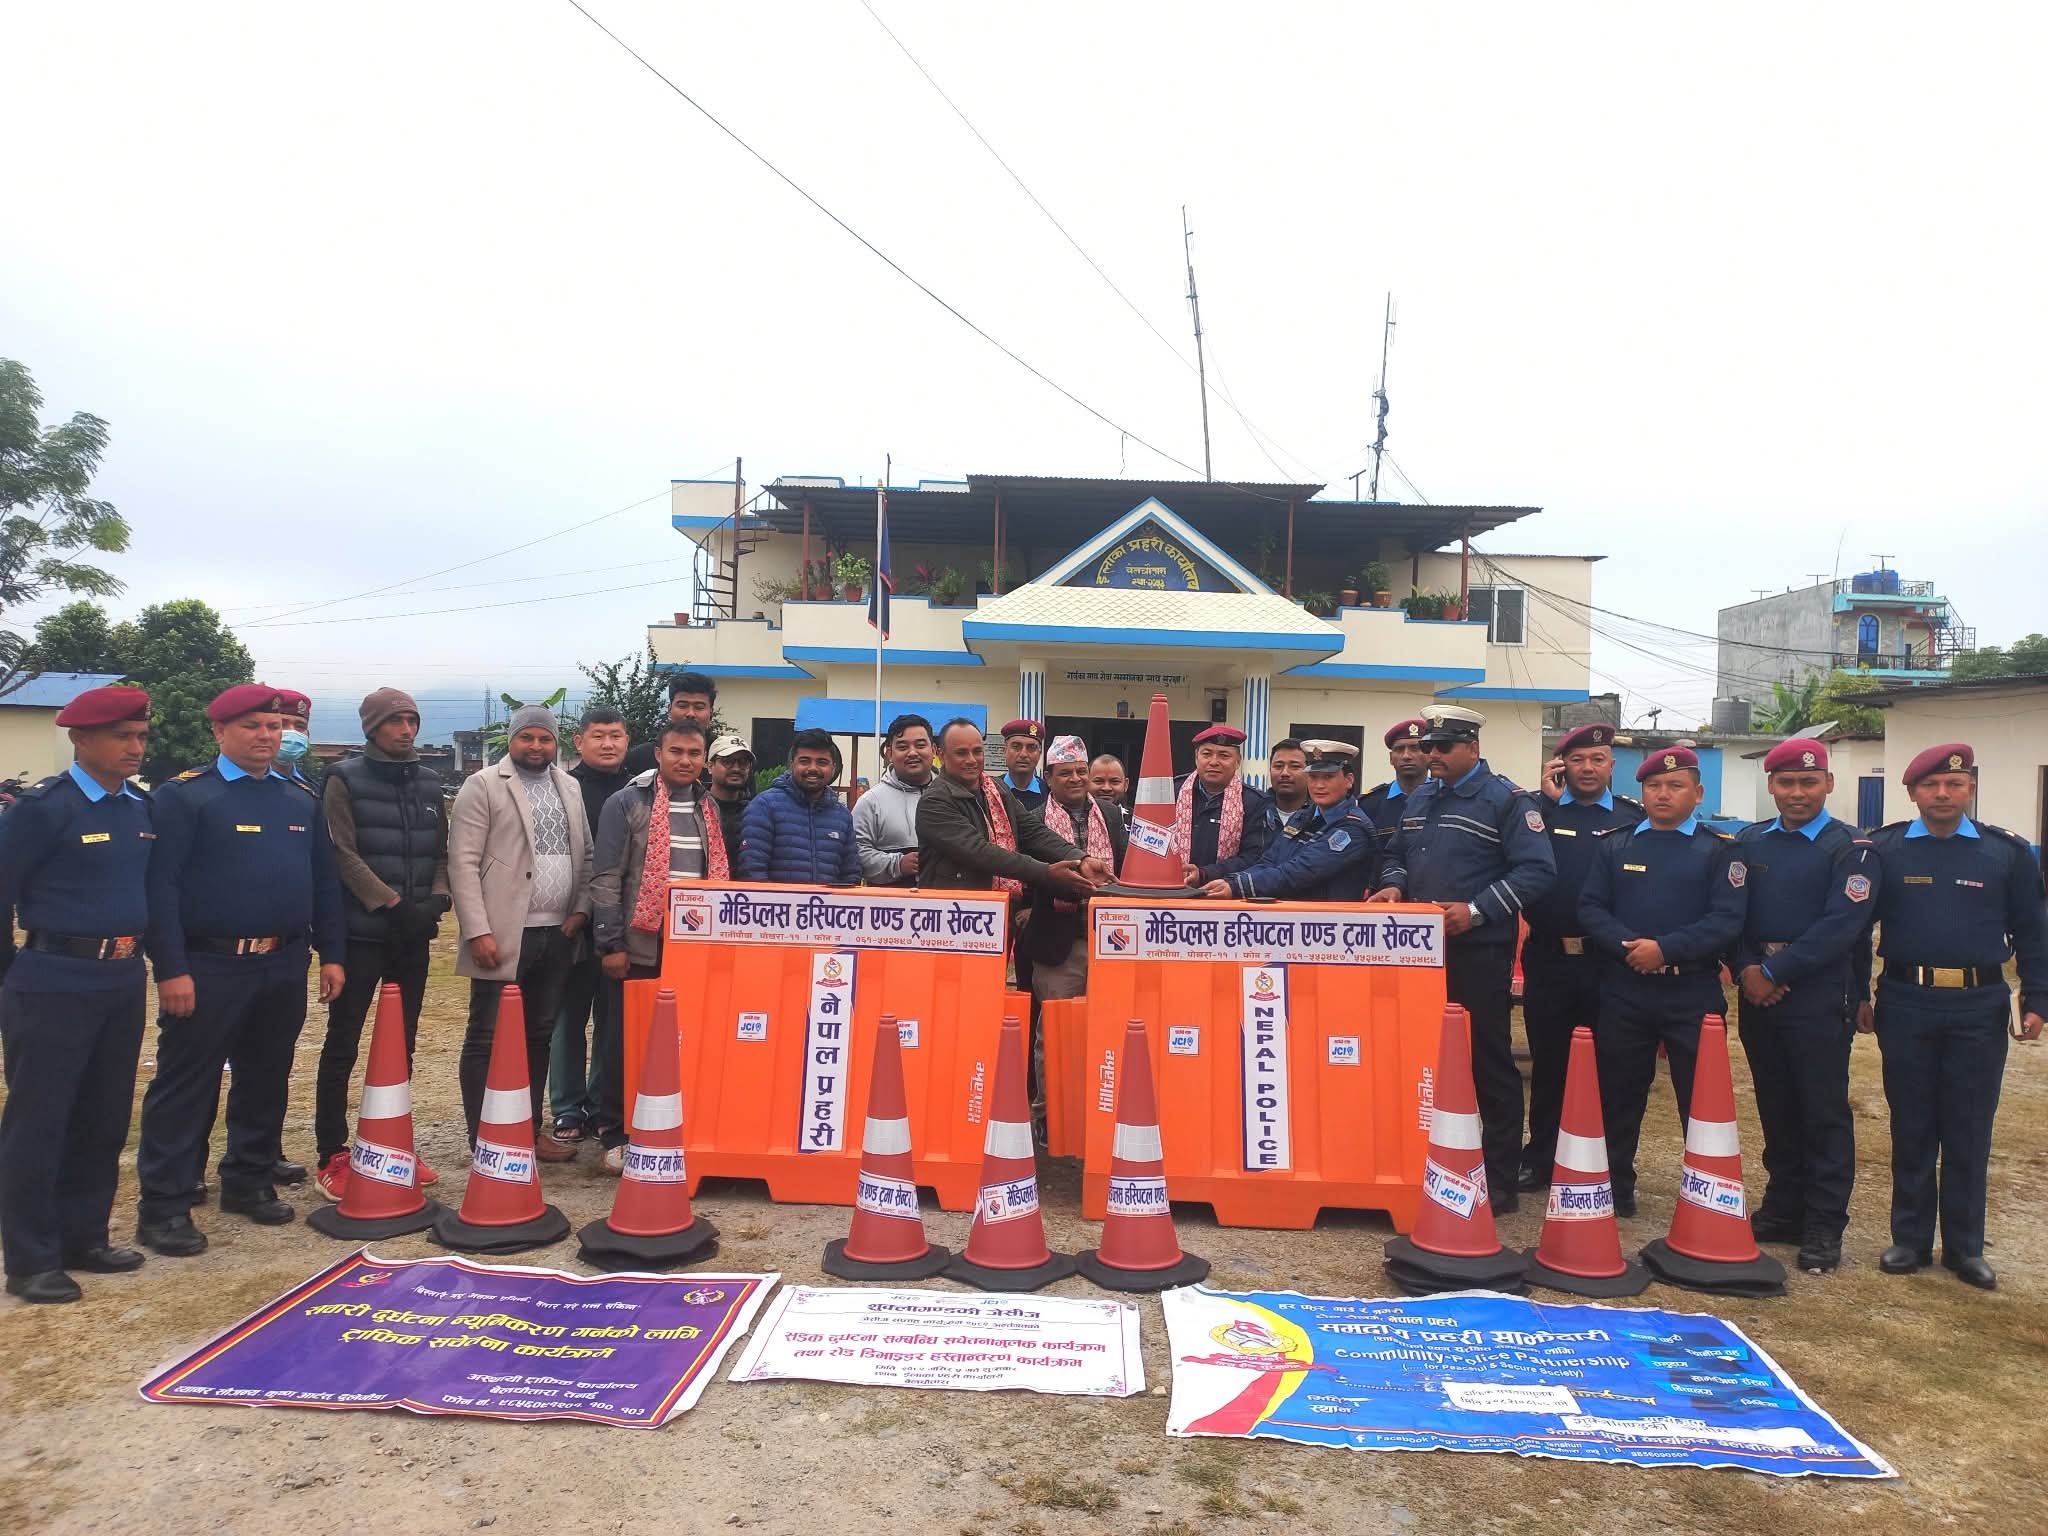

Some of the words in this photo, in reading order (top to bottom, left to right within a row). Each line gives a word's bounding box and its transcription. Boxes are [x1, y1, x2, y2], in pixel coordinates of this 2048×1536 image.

[1127, 536, 1165, 554] प्रहरी
[1165, 544, 1200, 590] कार्यालय
[1144, 836, 1158, 845] JCI
[719, 893, 791, 928] मेडिप्लस
[796, 896, 865, 931] हस्पिटल
[870, 906, 905, 932] एण्ड
[947, 902, 996, 937] सेन्टर
[1145, 911, 1219, 947] मेडिप्लस
[1223, 912, 1295, 948] हस्पिटल
[1300, 922, 1337, 947] एण्ड
[1382, 915, 1434, 950] सेन्टर
[741, 1022, 755, 1032] JCI
[1171, 1037, 1187, 1046] JCI
[1255, 1007, 1276, 1072] NEPAL
[1332, 1046, 1347, 1056] JCI
[1098, 1049, 1115, 1113] Hilltake
[1417, 1066, 1433, 1131] Hilltake
[1256, 1083, 1278, 1165] POLICE
[363, 1145, 384, 1169] सेन्टर
[480, 1144, 500, 1168] सेन्टर
[642, 1154, 657, 1171] एण्ड
[386, 1165, 403, 1175] JCI
[504, 1162, 521, 1172] JCI
[865, 1183, 879, 1201] एण्ड
[1125, 1182, 1153, 1205] हस्पिटल
[1690, 1172, 1710, 1197] सेन्टर
[1006, 1185, 1033, 1207] मेडिप्लस
[1440, 1188, 1459, 1201] JCI
[1560, 1187, 1591, 1209] मेडिप्लस
[1716, 1194, 1733, 1205] JCI
[304, 1303, 372, 1316] सवारी
[371, 1309, 450, 1327] दुर्घटना
[643, 1325, 702, 1340] लागि
[986, 1307, 1041, 1319] जेसीज
[1388, 1316, 1424, 1326] नेपाल
[1426, 1317, 1457, 1328] प्रहरी
[338, 1328, 427, 1344] ट्राफिक
[513, 1344, 616, 1359] कार्यक्रम
[785, 1331, 824, 1342] सडक
[1042, 1340, 1106, 1353] कार्यक्रम
[829, 1347, 854, 1357] रोड
[930, 1352, 1011, 1363] हस्तान्तरण
[1017, 1355, 1083, 1368] कार्यक्रम
[1515, 1350, 1630, 1369] Partnership
[1424, 1363, 1441, 1371] for
[1501, 1361, 1537, 1374] Secure
[524, 1376, 576, 1386] ट्राफिक
[577, 1380, 639, 1390] कार्यालय
[441, 1395, 472, 1406] फोन
[1376, 1435, 1429, 1444] Facebook
[1599, 1430, 1637, 1444] प्रहरी
